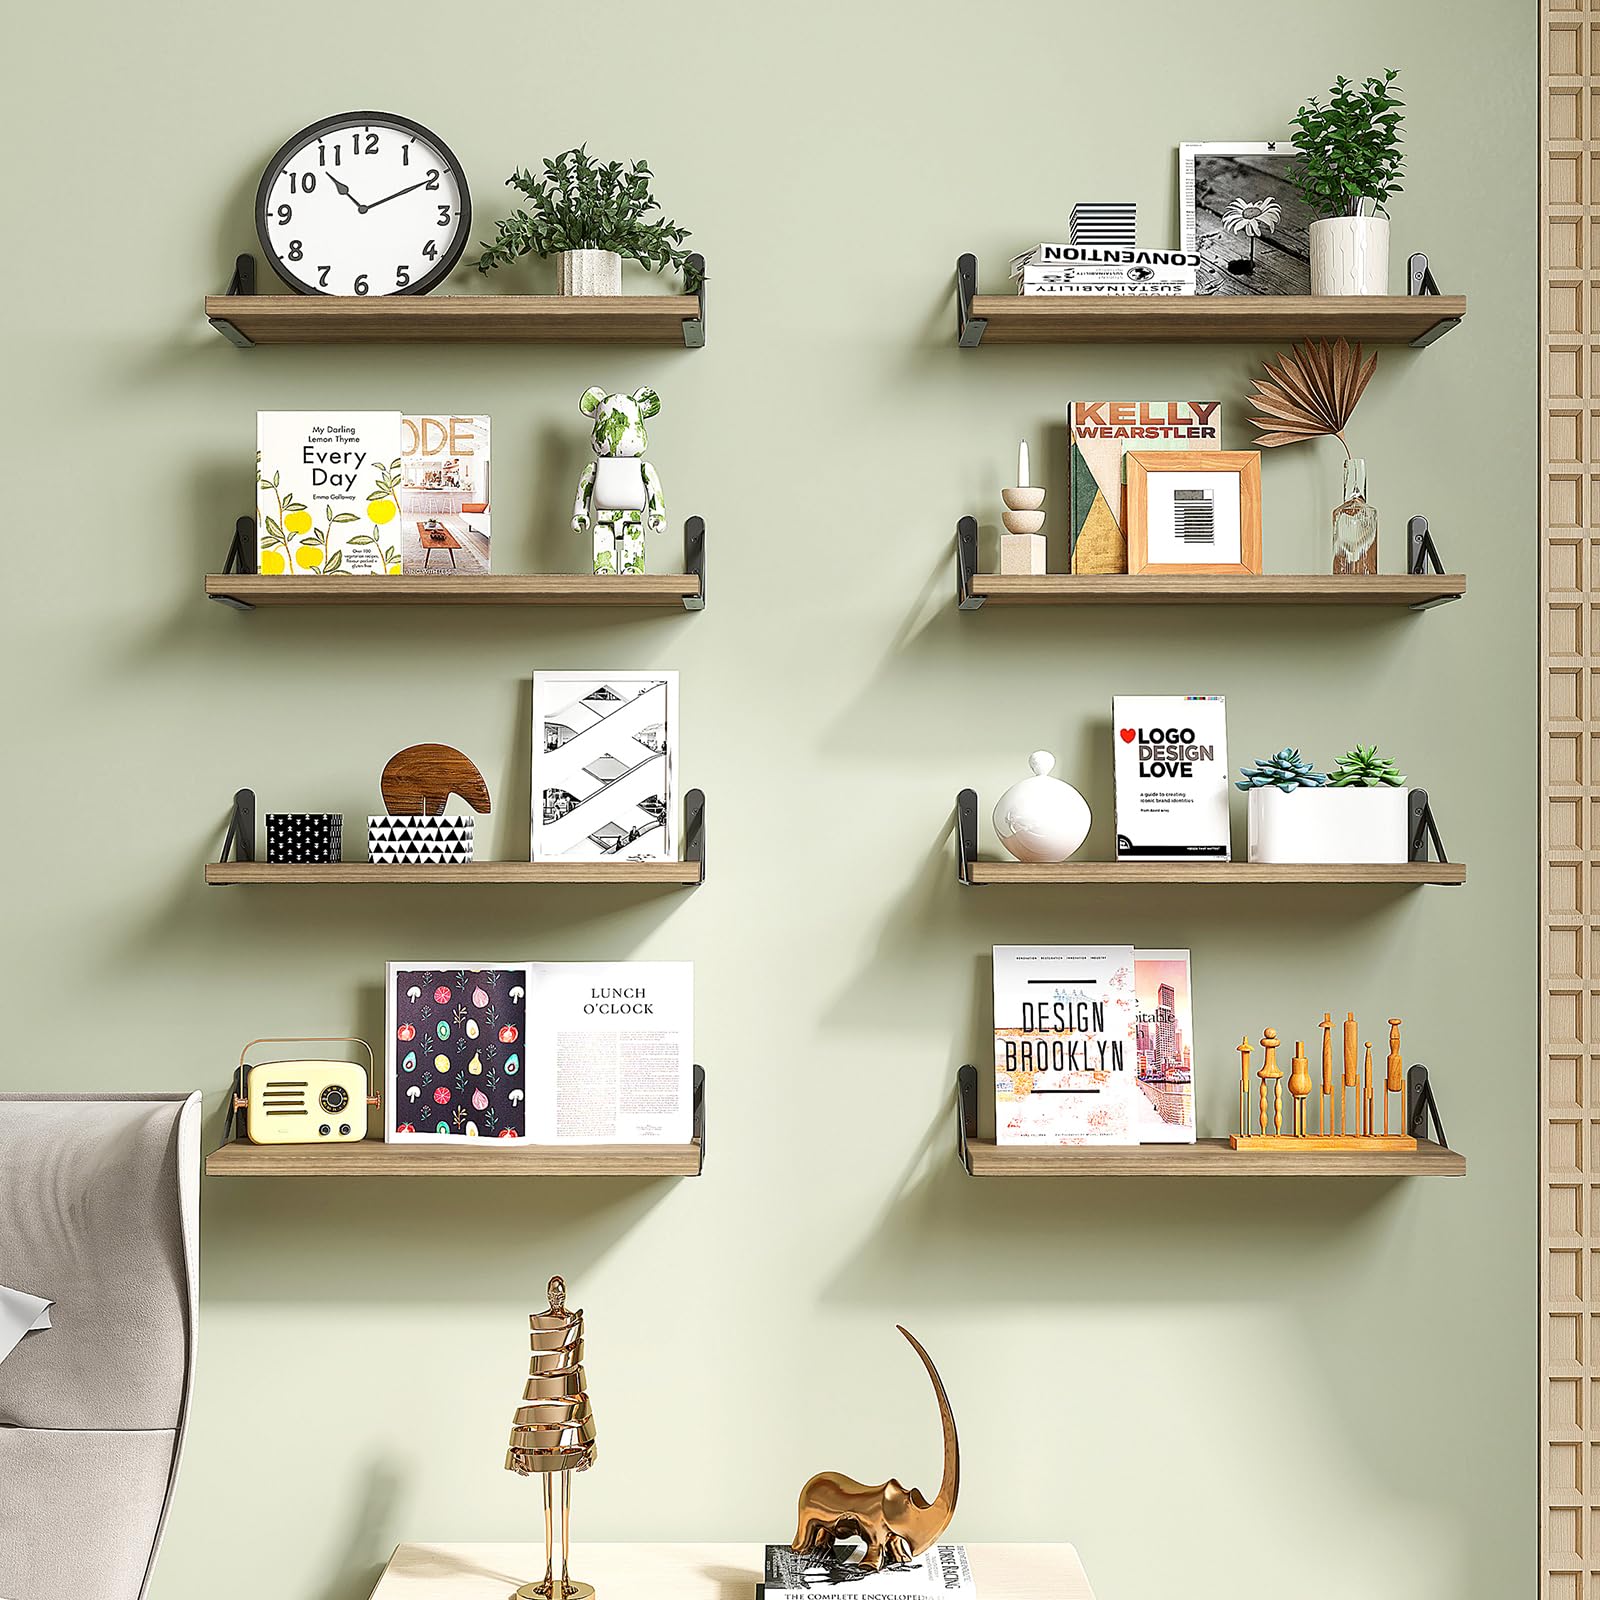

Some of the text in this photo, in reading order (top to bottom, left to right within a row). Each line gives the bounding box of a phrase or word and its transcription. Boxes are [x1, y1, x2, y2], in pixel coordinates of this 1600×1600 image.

[352, 134, 379, 154] 12
[318, 145, 341, 166] 11
[402, 145, 409, 166] 1
[289, 172, 316, 193] 10
[425, 169, 440, 190] 2
[277, 204, 292, 225] 9
[437, 205, 450, 226] 3
[288, 240, 303, 261] 8
[422, 240, 438, 261] 4
[1044, 247, 1200, 266] CONVENTION
[318, 266, 331, 287] 7
[354, 274, 369, 296] 6
[396, 265, 409, 286] 5
[1075, 402, 1220, 426] KELLY
[312, 425, 356, 435] My Darling
[336, 435, 360, 444] Thyme
[1076, 427, 1216, 439] WEARSTLER
[303, 446, 367, 470] Every
[312, 468, 357, 492] Day
[1138, 728, 1195, 744] LOGO
[1139, 745, 1214, 761] DESIGN
[1139, 762, 1193, 778] LOVE
[591, 988, 646, 998] LUNCH
[584, 1004, 654, 1014] O'CLOCK
[1023, 1002, 1104, 1033] DESIGN
[1006, 1040, 1124, 1072] BROOKLYN
[937, 1546, 956, 1564] HORSE
[942, 1566, 960, 1589] RACING
